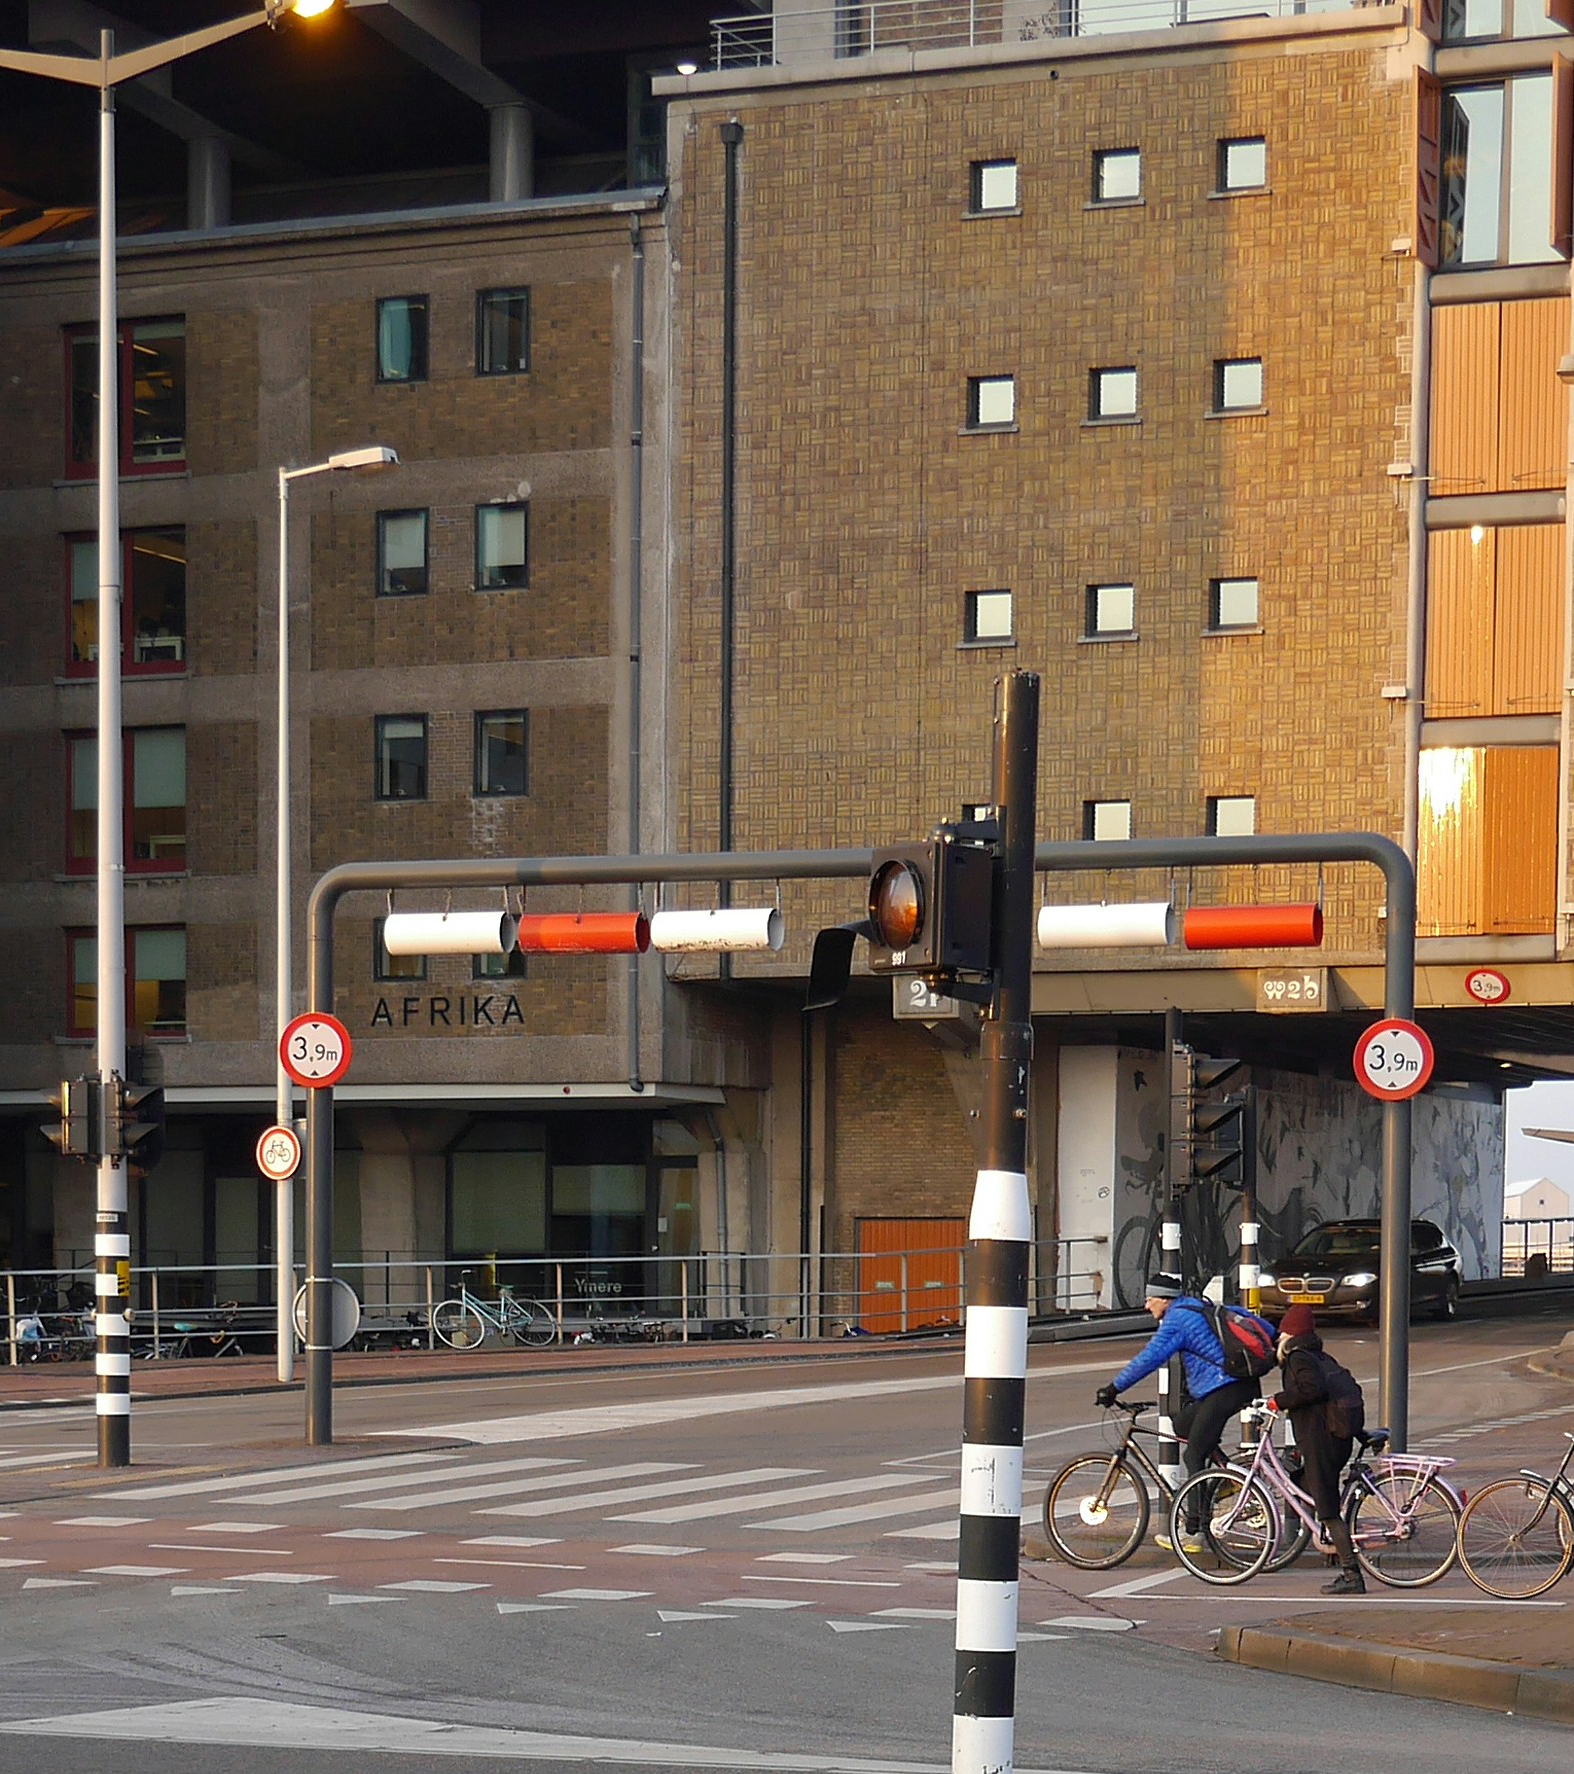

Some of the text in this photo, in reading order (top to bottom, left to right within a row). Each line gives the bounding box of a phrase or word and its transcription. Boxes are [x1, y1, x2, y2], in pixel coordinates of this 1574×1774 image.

[371, 994, 525, 1027] AFRIKA
[292, 1035, 338, 1063] 3,9m
[1368, 1044, 1419, 1073] 3,9m
